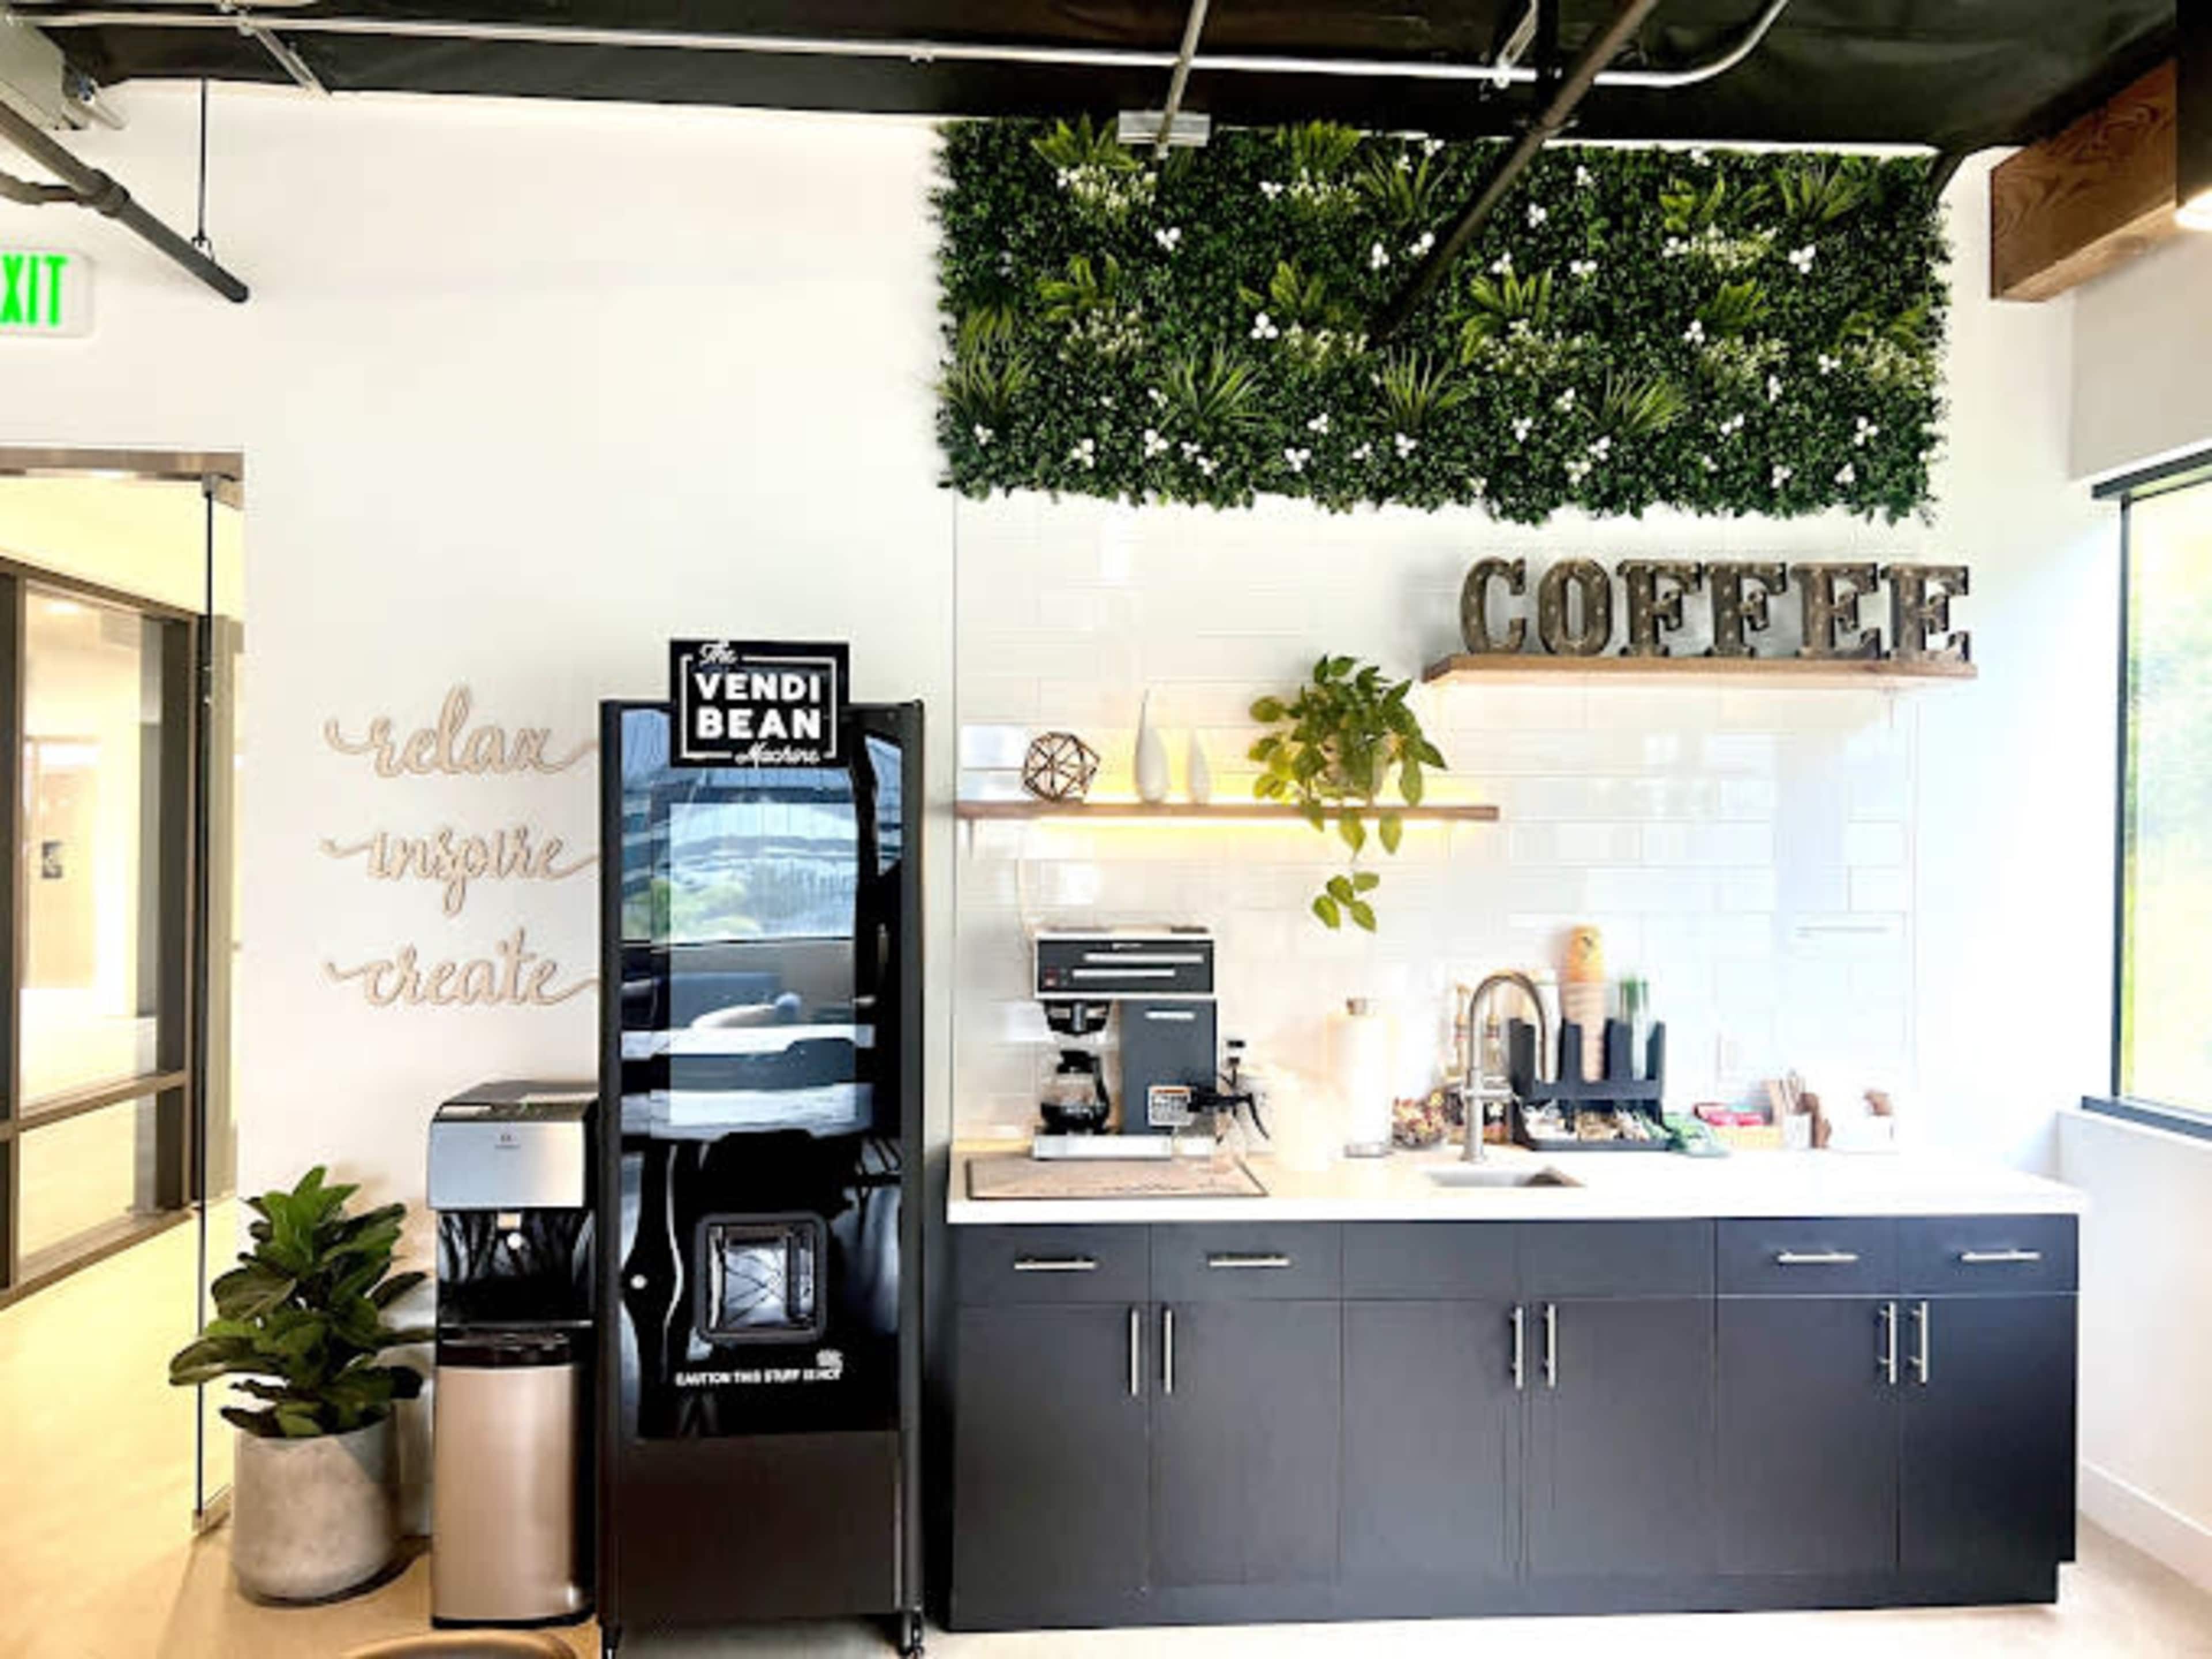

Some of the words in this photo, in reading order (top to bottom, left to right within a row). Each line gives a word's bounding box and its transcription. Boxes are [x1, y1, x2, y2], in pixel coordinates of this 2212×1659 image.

[1460, 556, 1971, 662] COFFEE
[694, 673, 821, 702] VENDI
[695, 706, 821, 740] BEAN
[324, 685, 598, 778] relax
[320, 824, 598, 916] inspire
[324, 926, 598, 1006] create
